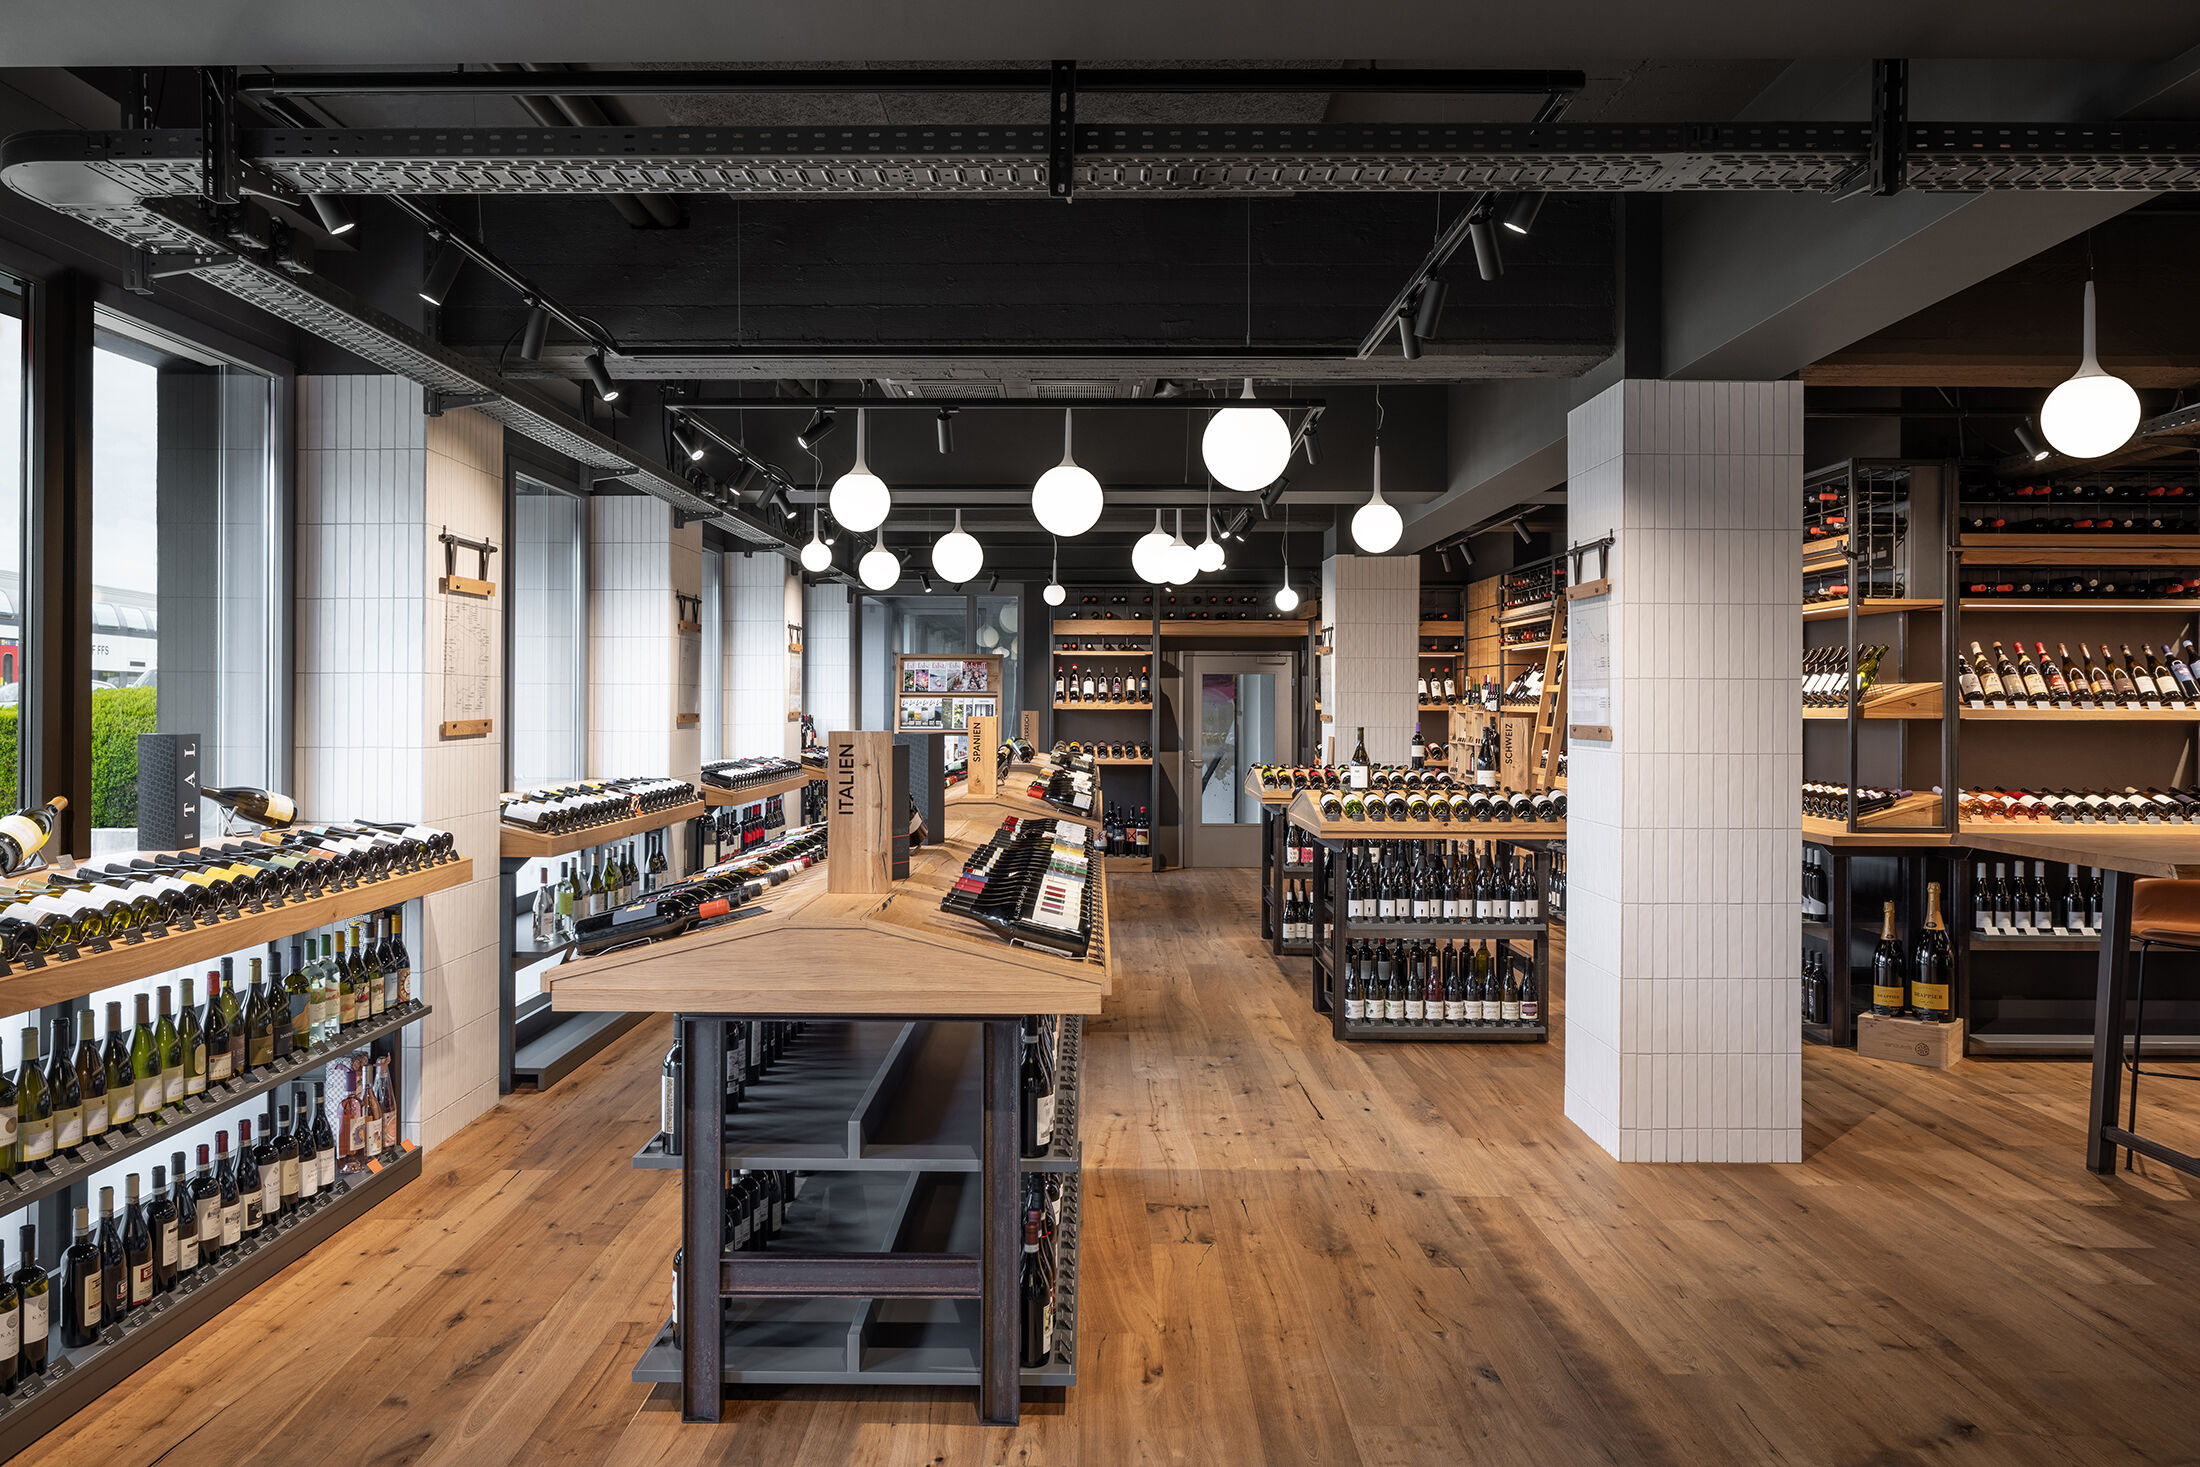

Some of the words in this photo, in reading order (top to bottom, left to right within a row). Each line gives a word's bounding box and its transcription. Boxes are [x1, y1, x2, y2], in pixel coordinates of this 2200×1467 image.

[973, 722, 981, 762] SPANIEN
[1505, 723, 1513, 764] SCHWEIZ
[839, 744, 854, 814] ITALIEN
